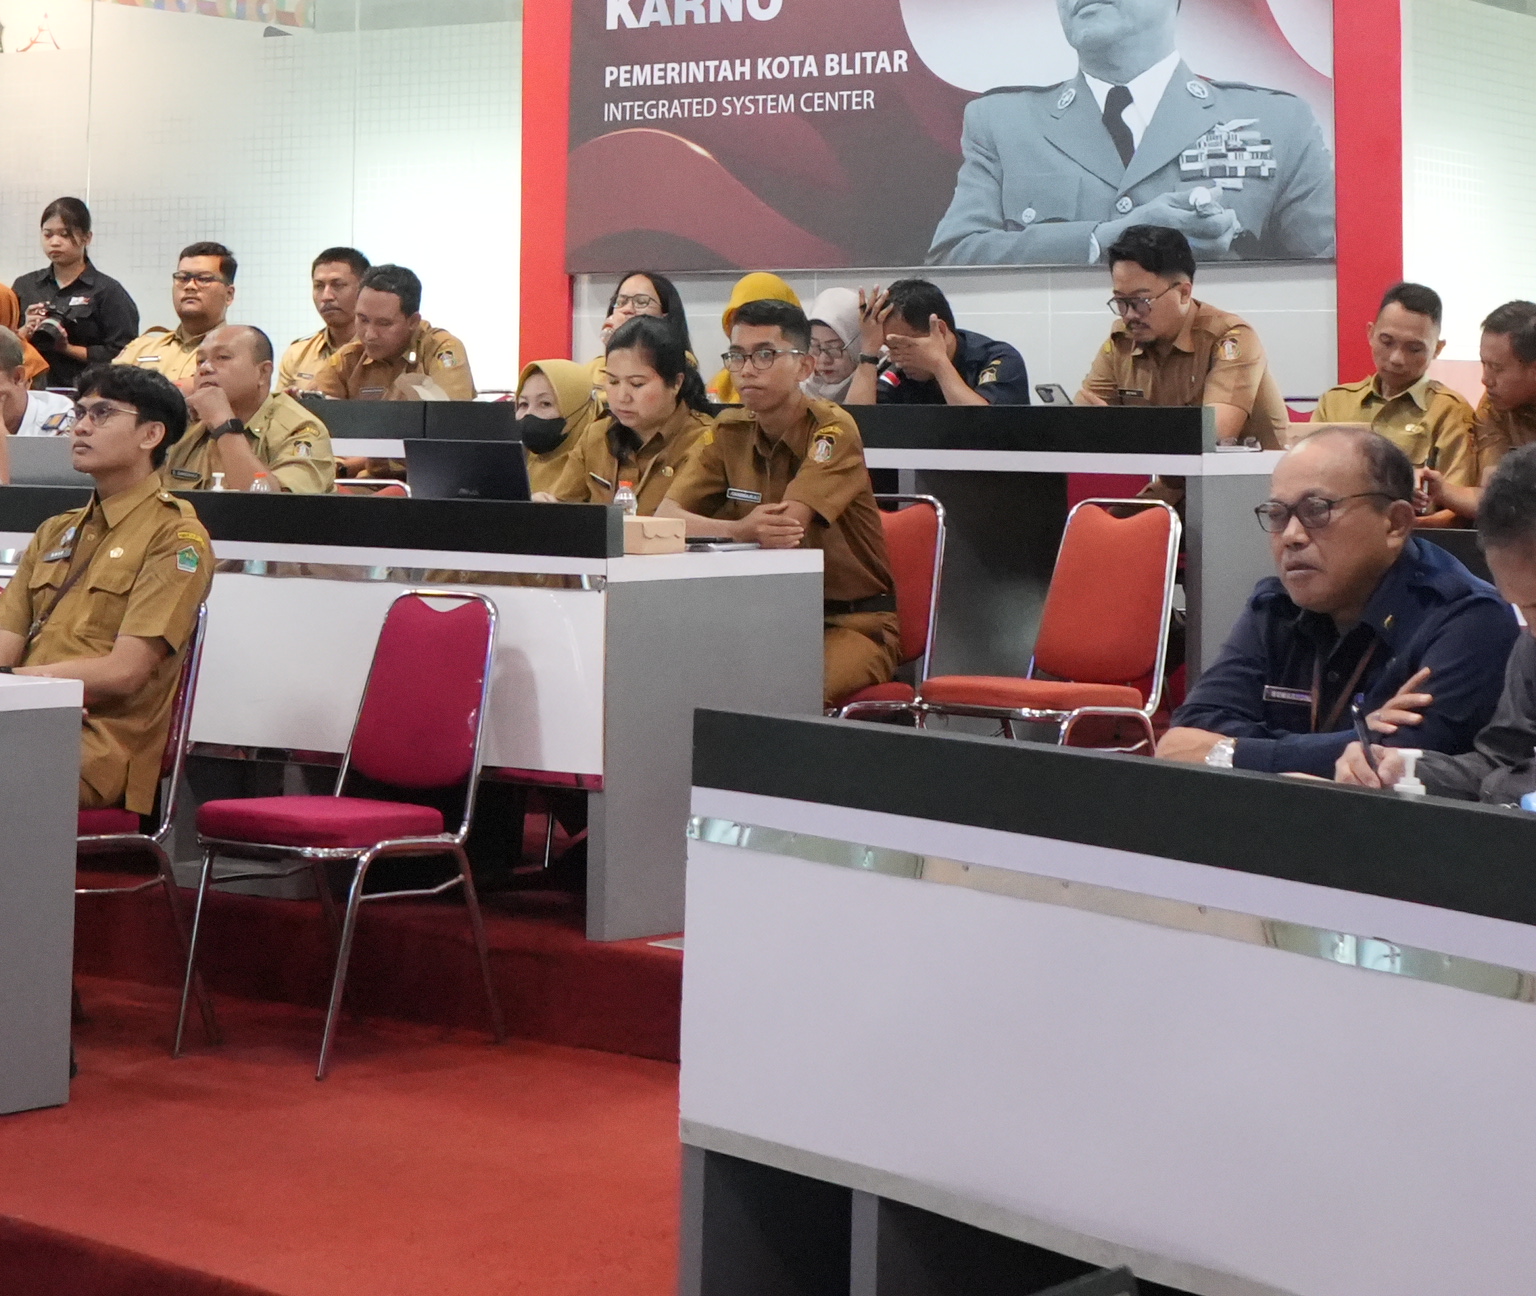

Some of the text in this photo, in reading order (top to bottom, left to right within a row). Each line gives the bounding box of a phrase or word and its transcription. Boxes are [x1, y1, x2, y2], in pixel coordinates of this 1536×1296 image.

[605, 50, 908, 87] PEMERINTAH KOTA BLITAR
[604, 90, 875, 121] INTEGRATED SYSTEM CENTER
